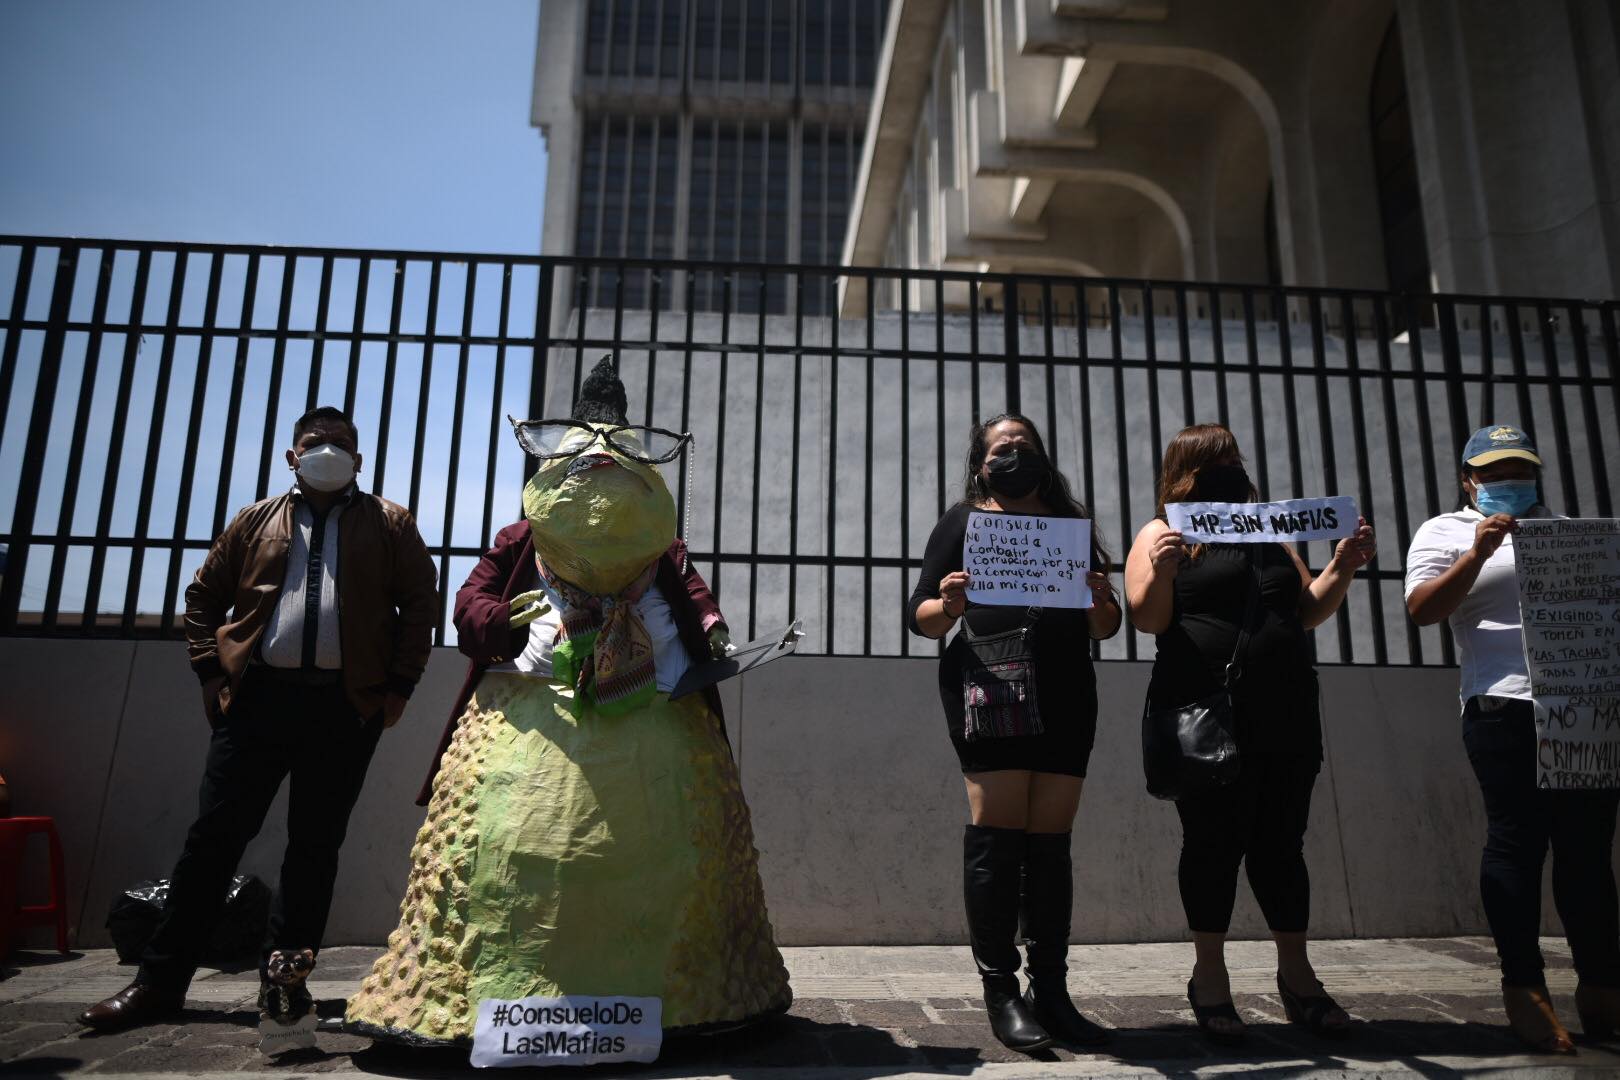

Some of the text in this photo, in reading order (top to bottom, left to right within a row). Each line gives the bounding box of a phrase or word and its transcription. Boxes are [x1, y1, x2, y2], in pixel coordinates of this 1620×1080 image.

[1190, 513, 1225, 535] MP.
[1231, 513, 1263, 534] SIN
[1561, 551, 1608, 563] GENERAL
[1528, 580, 1544, 591] NO
[1536, 609, 1603, 622] EXIGIMOS
[1594, 626, 1615, 637] EN
[1547, 705, 1577, 730] NO
[493, 1001, 643, 1027] #ConsueloDe
[502, 1031, 625, 1055] LasMafias
